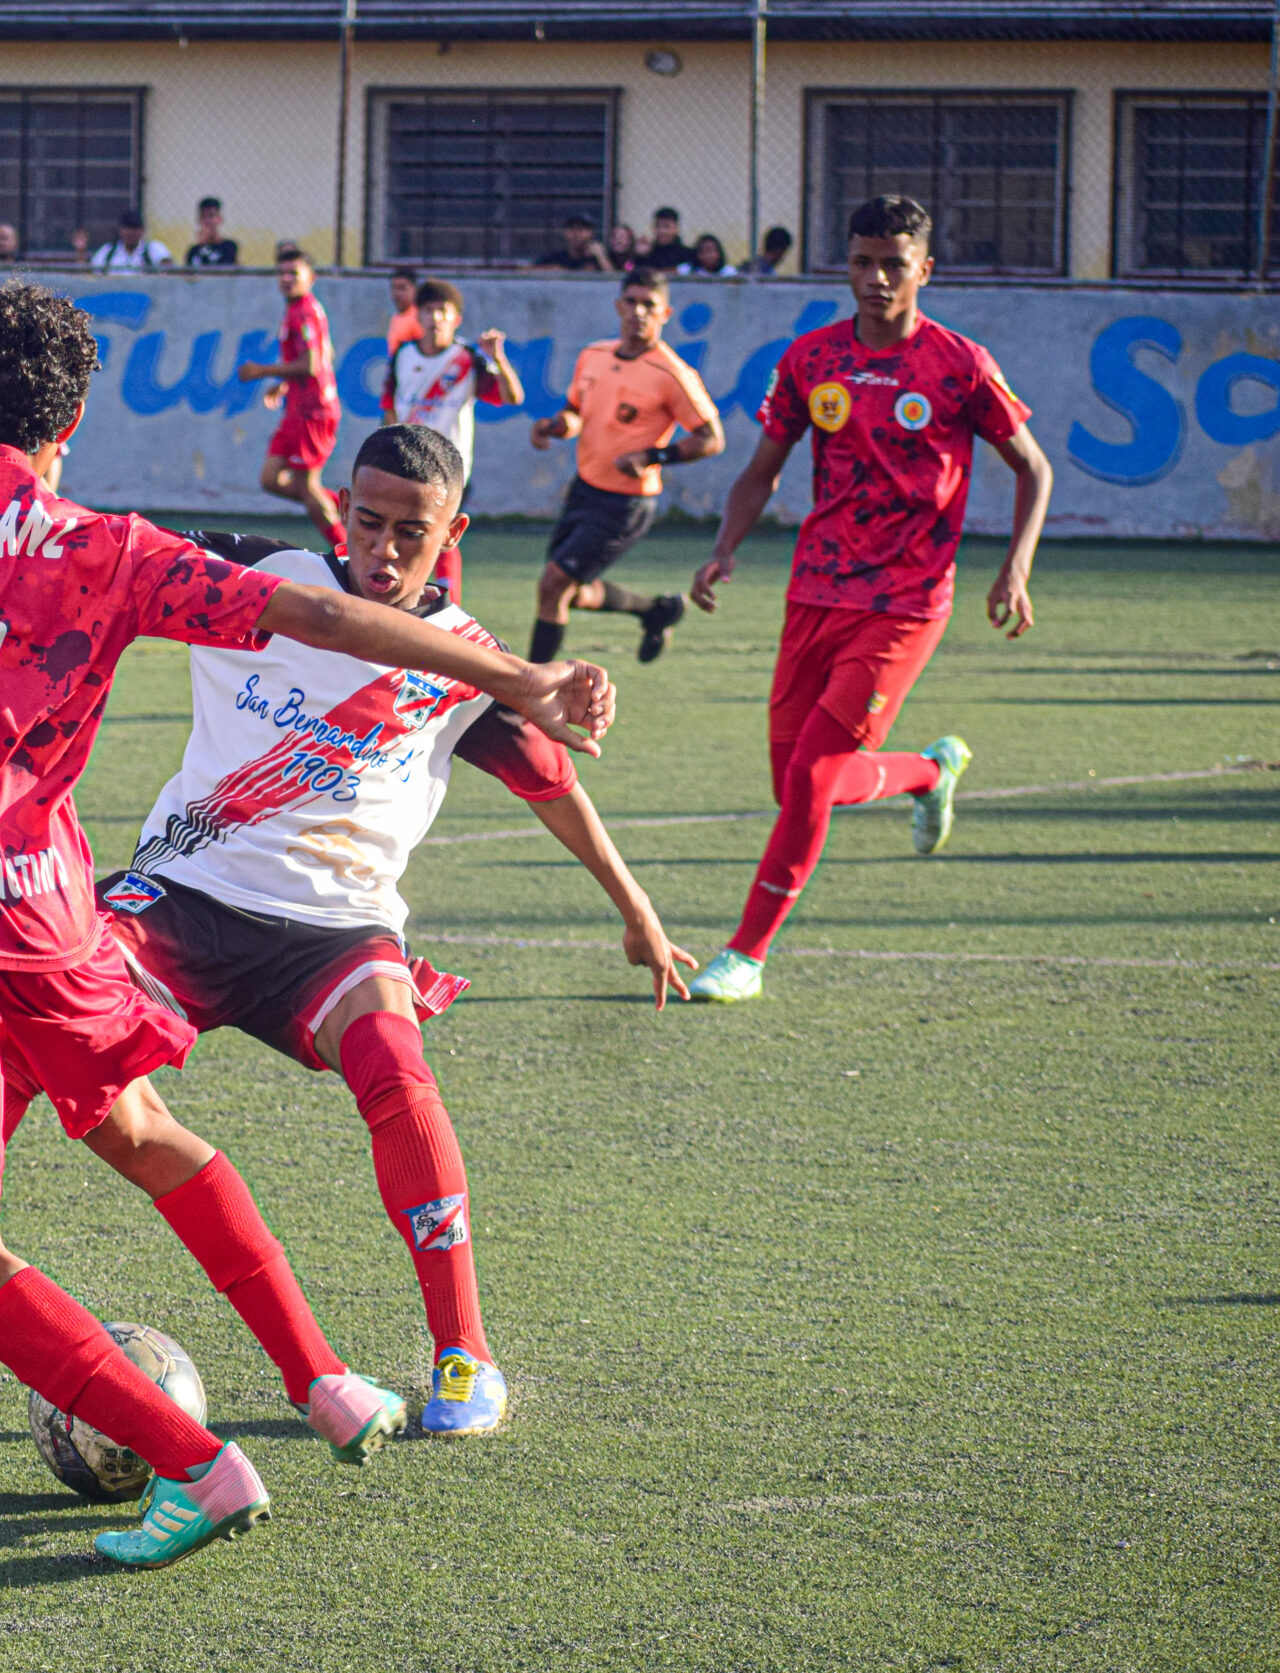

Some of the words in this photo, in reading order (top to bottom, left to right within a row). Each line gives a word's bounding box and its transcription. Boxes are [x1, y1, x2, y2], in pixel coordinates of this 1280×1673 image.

[235, 673, 271, 720] San
[273, 687, 389, 769] Bernardino
[282, 752, 362, 802] 1903
